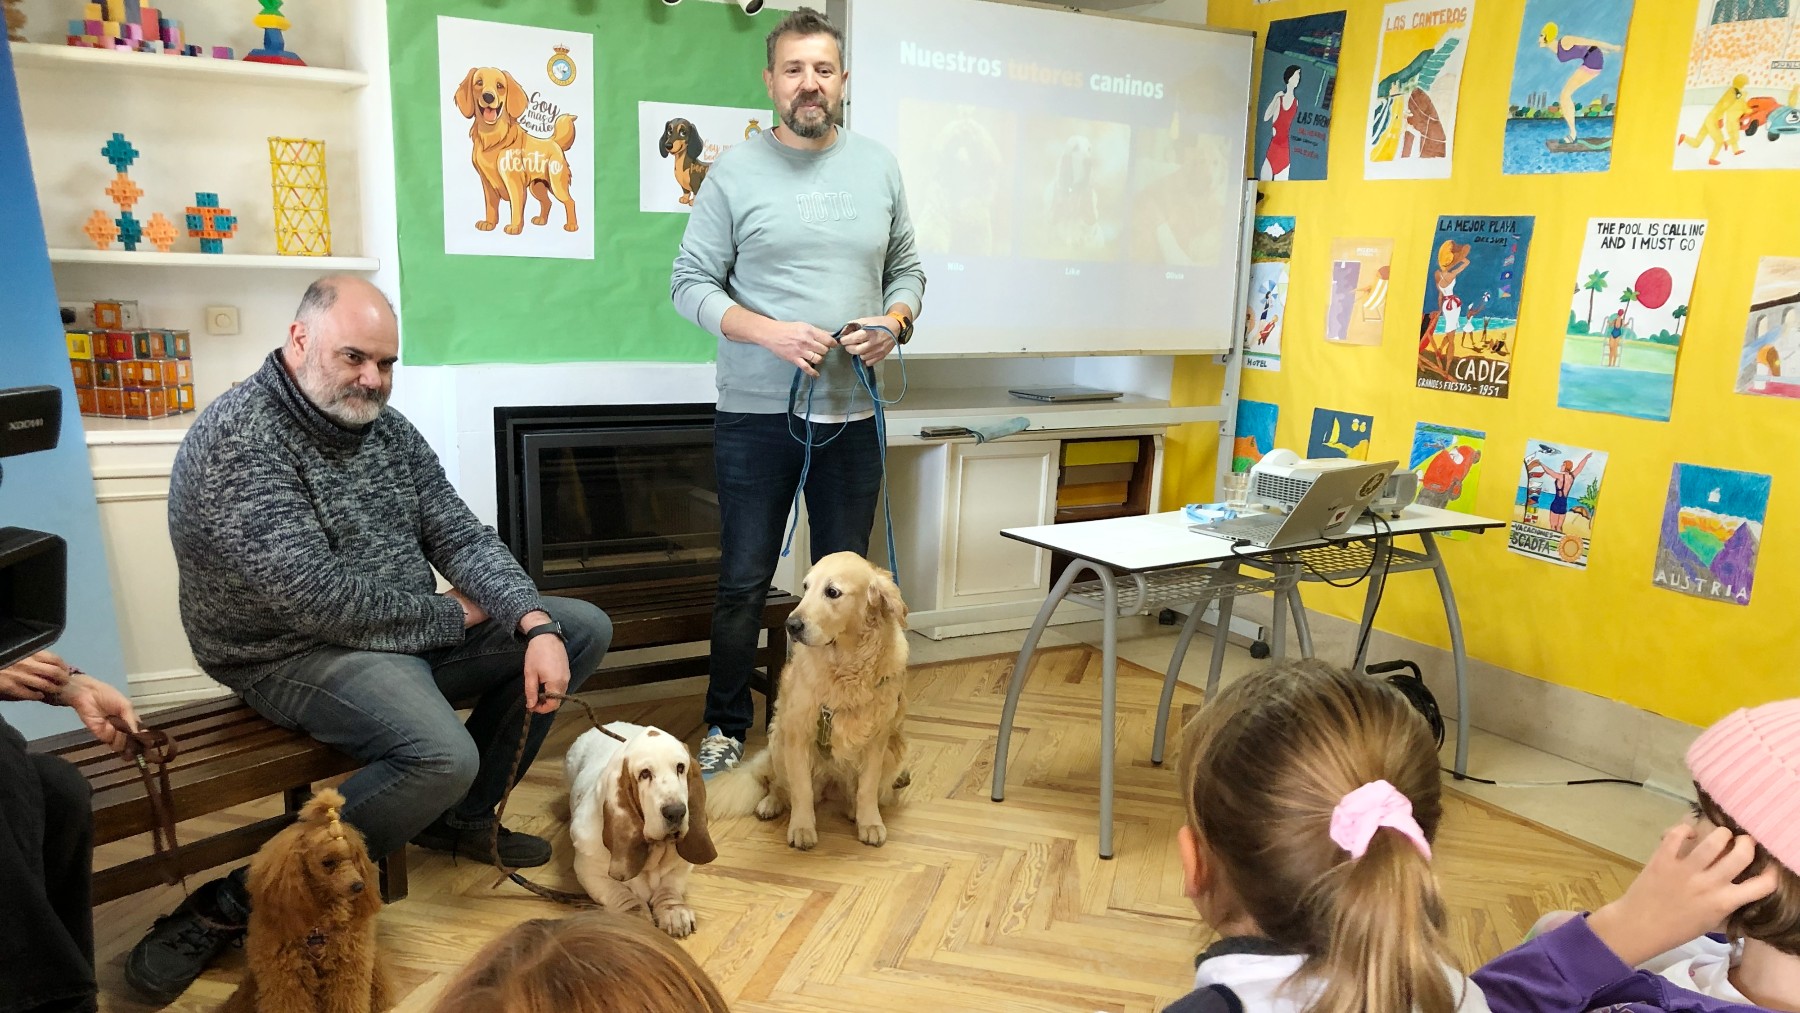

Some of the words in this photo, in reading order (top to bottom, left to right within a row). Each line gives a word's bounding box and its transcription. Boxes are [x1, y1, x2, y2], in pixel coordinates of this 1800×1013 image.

[1386, 15, 1406, 32] LAS
[1412, 7, 1467, 29] CANTERAS
[900, 41, 1002, 78] Nuestros
[1008, 58, 1084, 88] tutores
[1090, 72, 1164, 99] caninos
[530, 91, 560, 123] Soy
[1297, 111, 1313, 125] LAS
[519, 114, 554, 133] bonito
[499, 149, 563, 175] dentro
[1439, 219, 1453, 232] LA
[1454, 219, 1486, 233] MEJOR
[1489, 220, 1516, 233] PLAYA
[1597, 222, 1616, 235] THE
[1618, 222, 1644, 236] POOL
[1648, 222, 1660, 236] IS
[1663, 223, 1705, 236] CALLING
[1601, 236, 1626, 249] AND
[1632, 237, 1637, 250] I
[1640, 237, 1675, 250] MUST
[1680, 238, 1696, 251] GO
[1455, 358, 1510, 385] CADIZ
[1443, 381, 1472, 393] FIESTAS
[1480, 384, 1500, 397] 1951
[1655, 569, 1748, 600] AUSTRIA
